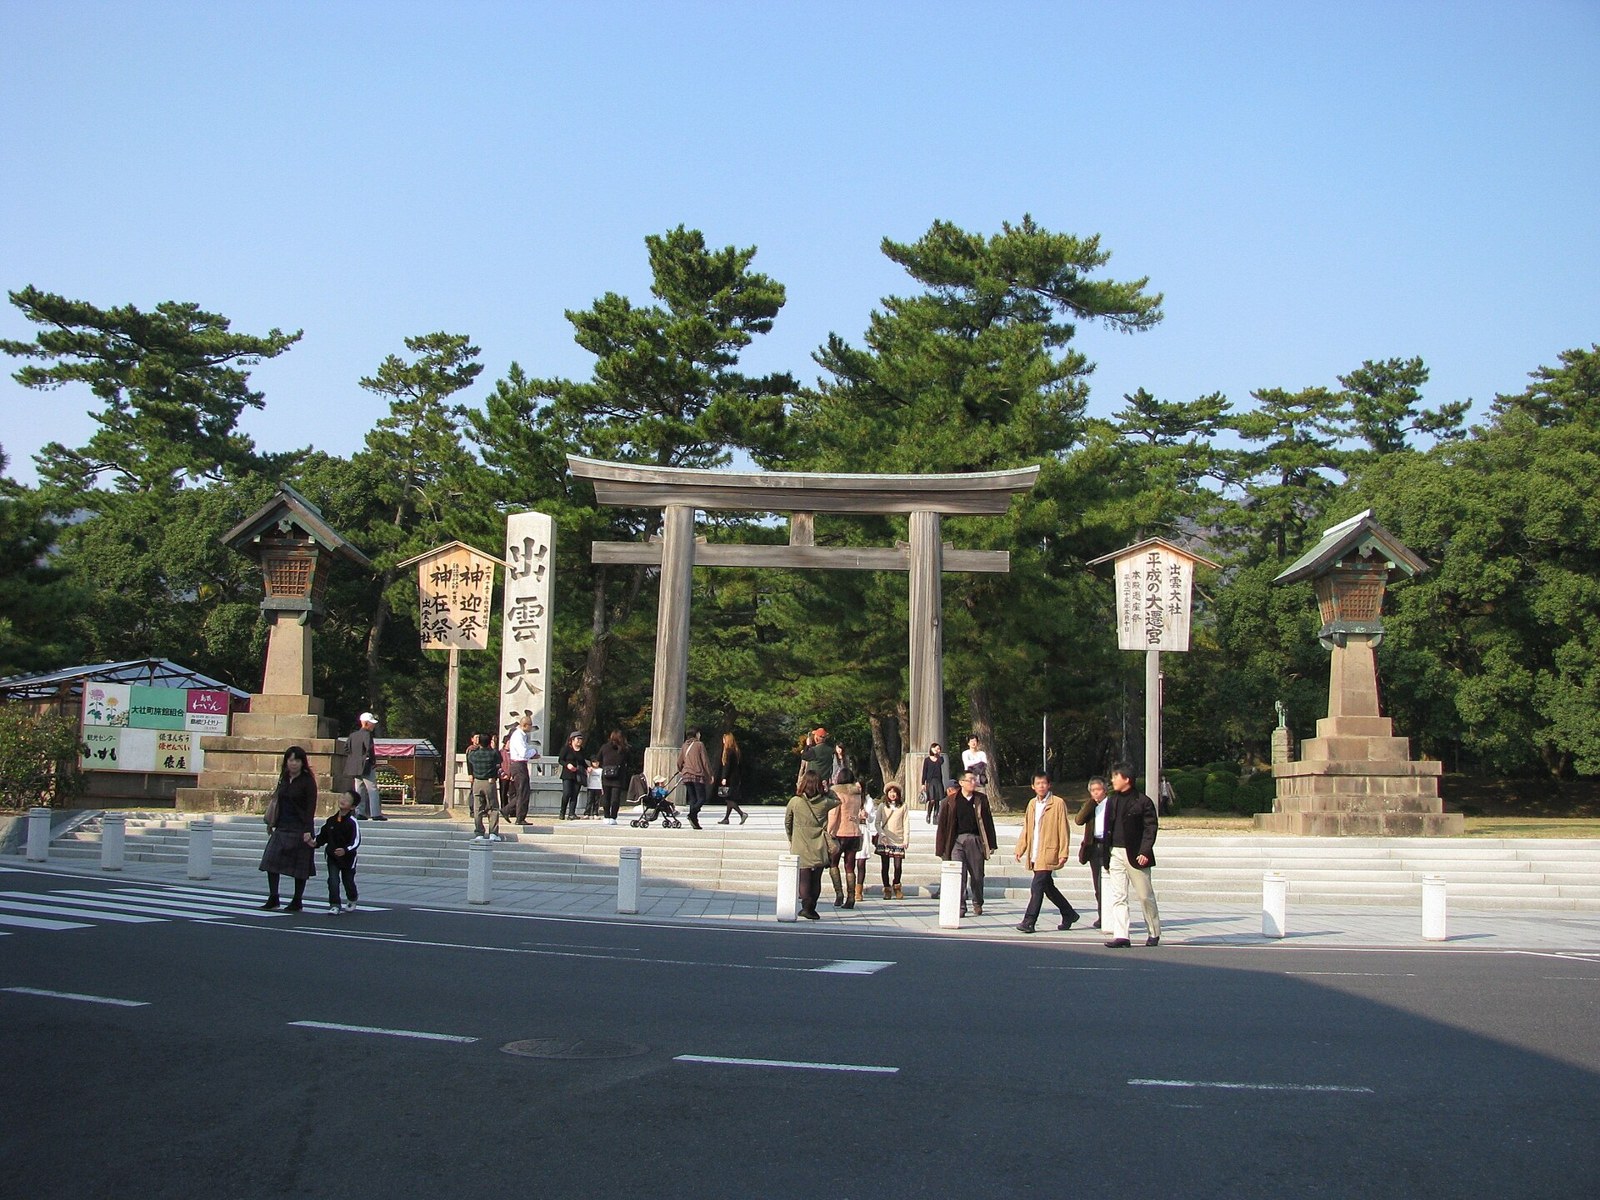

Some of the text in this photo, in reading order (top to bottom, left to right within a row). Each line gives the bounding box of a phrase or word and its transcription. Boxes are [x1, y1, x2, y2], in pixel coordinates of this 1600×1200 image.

[429, 563, 453, 642] 神在祭
[457, 562, 485, 641] 神迎祭
[1145, 552, 1164, 645] 平成の大遷宮
[1168, 563, 1182, 616] 出雲大社
[131, 706, 184, 717] 大社町旅館組合
